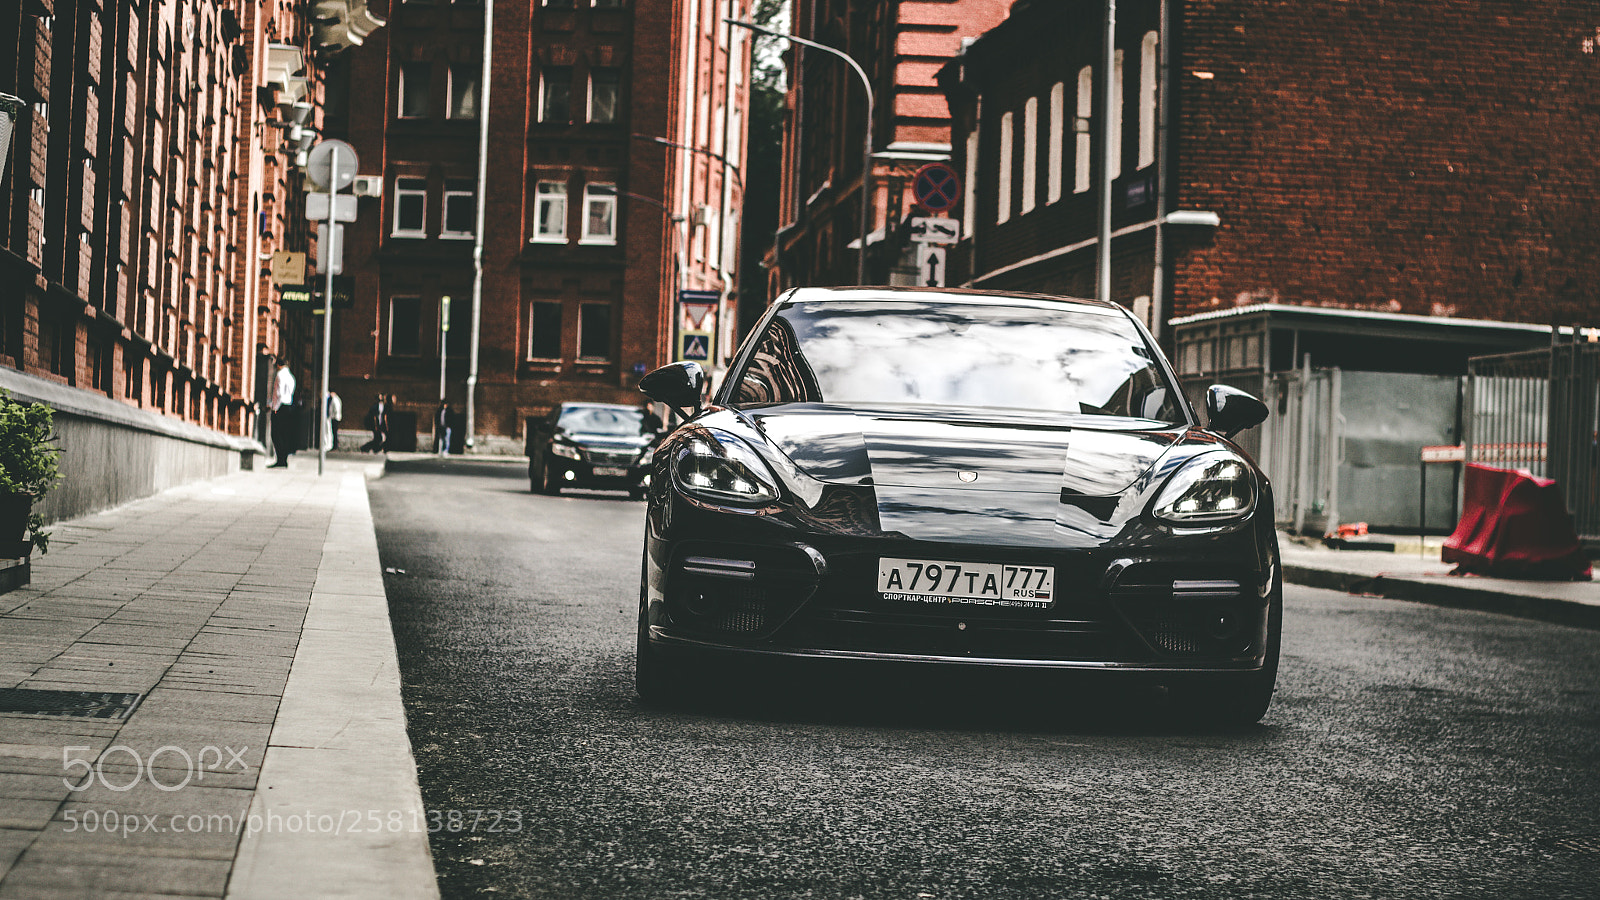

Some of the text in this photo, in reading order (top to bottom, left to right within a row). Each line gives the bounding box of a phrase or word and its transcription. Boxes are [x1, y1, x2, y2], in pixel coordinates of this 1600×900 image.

[1005, 566, 1047, 589] 777
[883, 593, 947, 603] СПОРТКАР-ЦЕНТР
[951, 597, 1010, 607] PORSCHE
[1013, 589, 1035, 598] RUS
